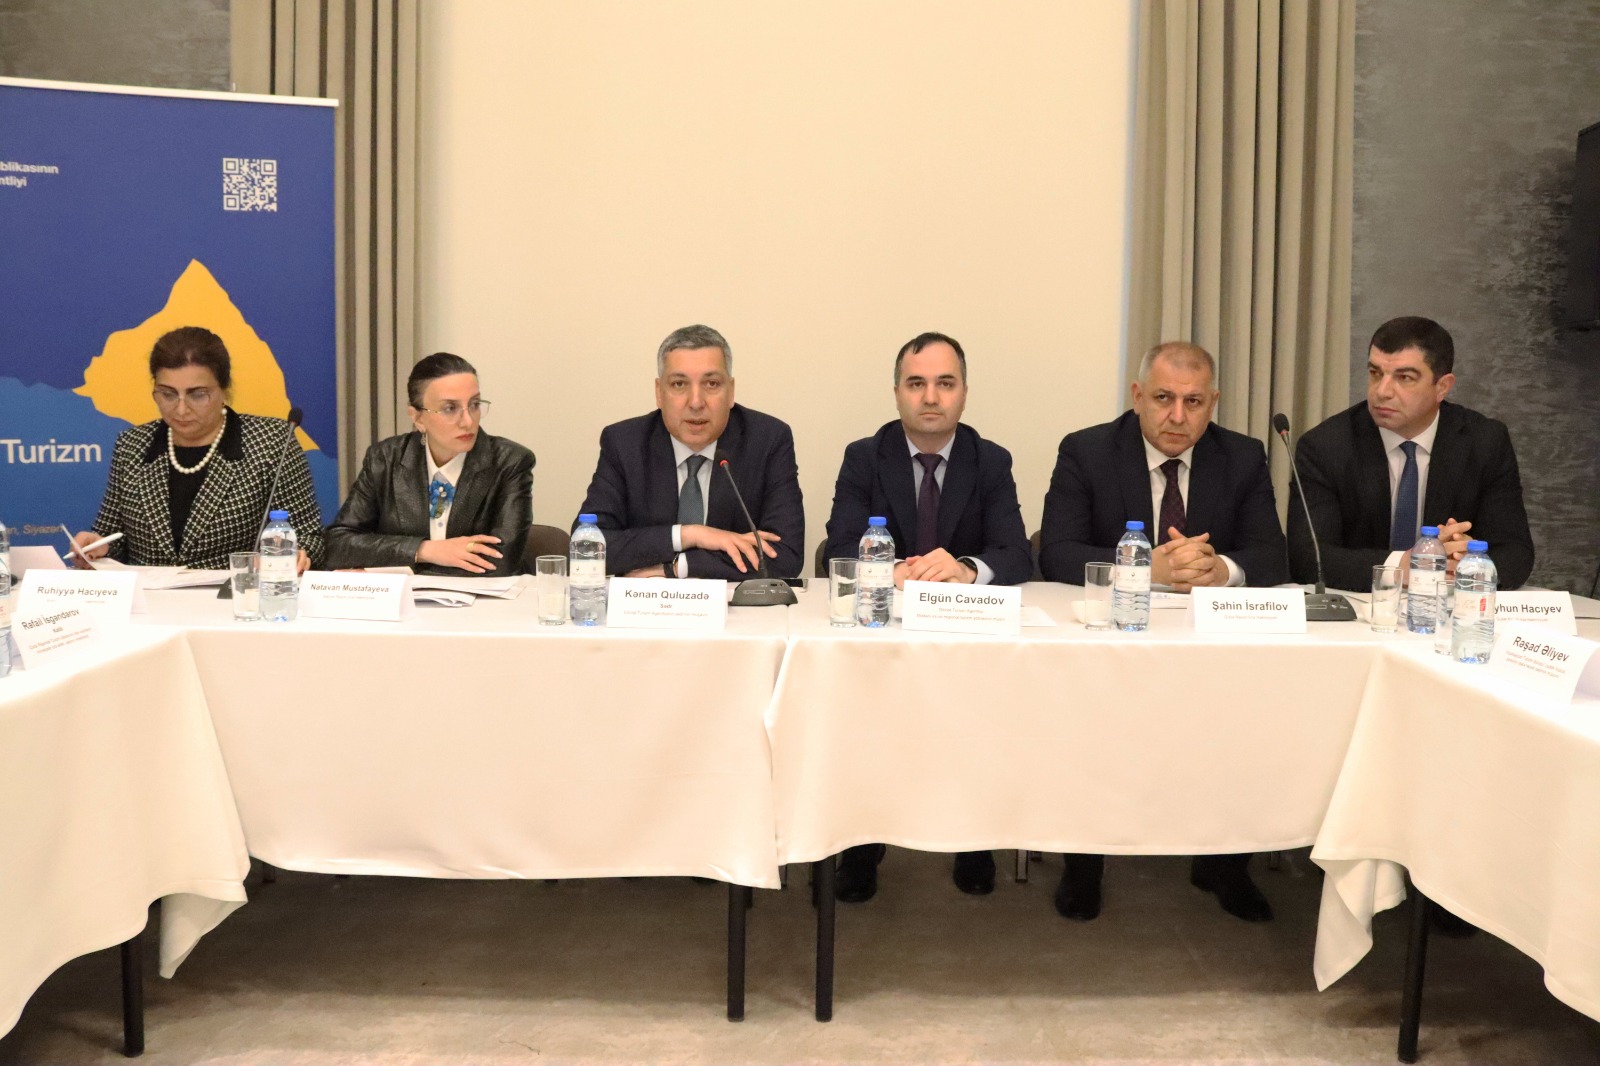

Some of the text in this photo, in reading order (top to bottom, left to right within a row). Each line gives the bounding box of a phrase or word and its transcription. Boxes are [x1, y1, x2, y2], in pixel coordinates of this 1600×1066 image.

[0, 439, 102, 464] Turizm
[624, 590, 658, 599] Kənan
[919, 592, 1005, 606] Elgün Cavadov
[1211, 599, 1289, 612] Şahin İsrafilov
[1494, 604, 1519, 615] yhun
[1521, 604, 1562, 615] Hacıyev
[1512, 636, 1542, 653] Rəşad
[1540, 645, 1570, 662] Əliyev
